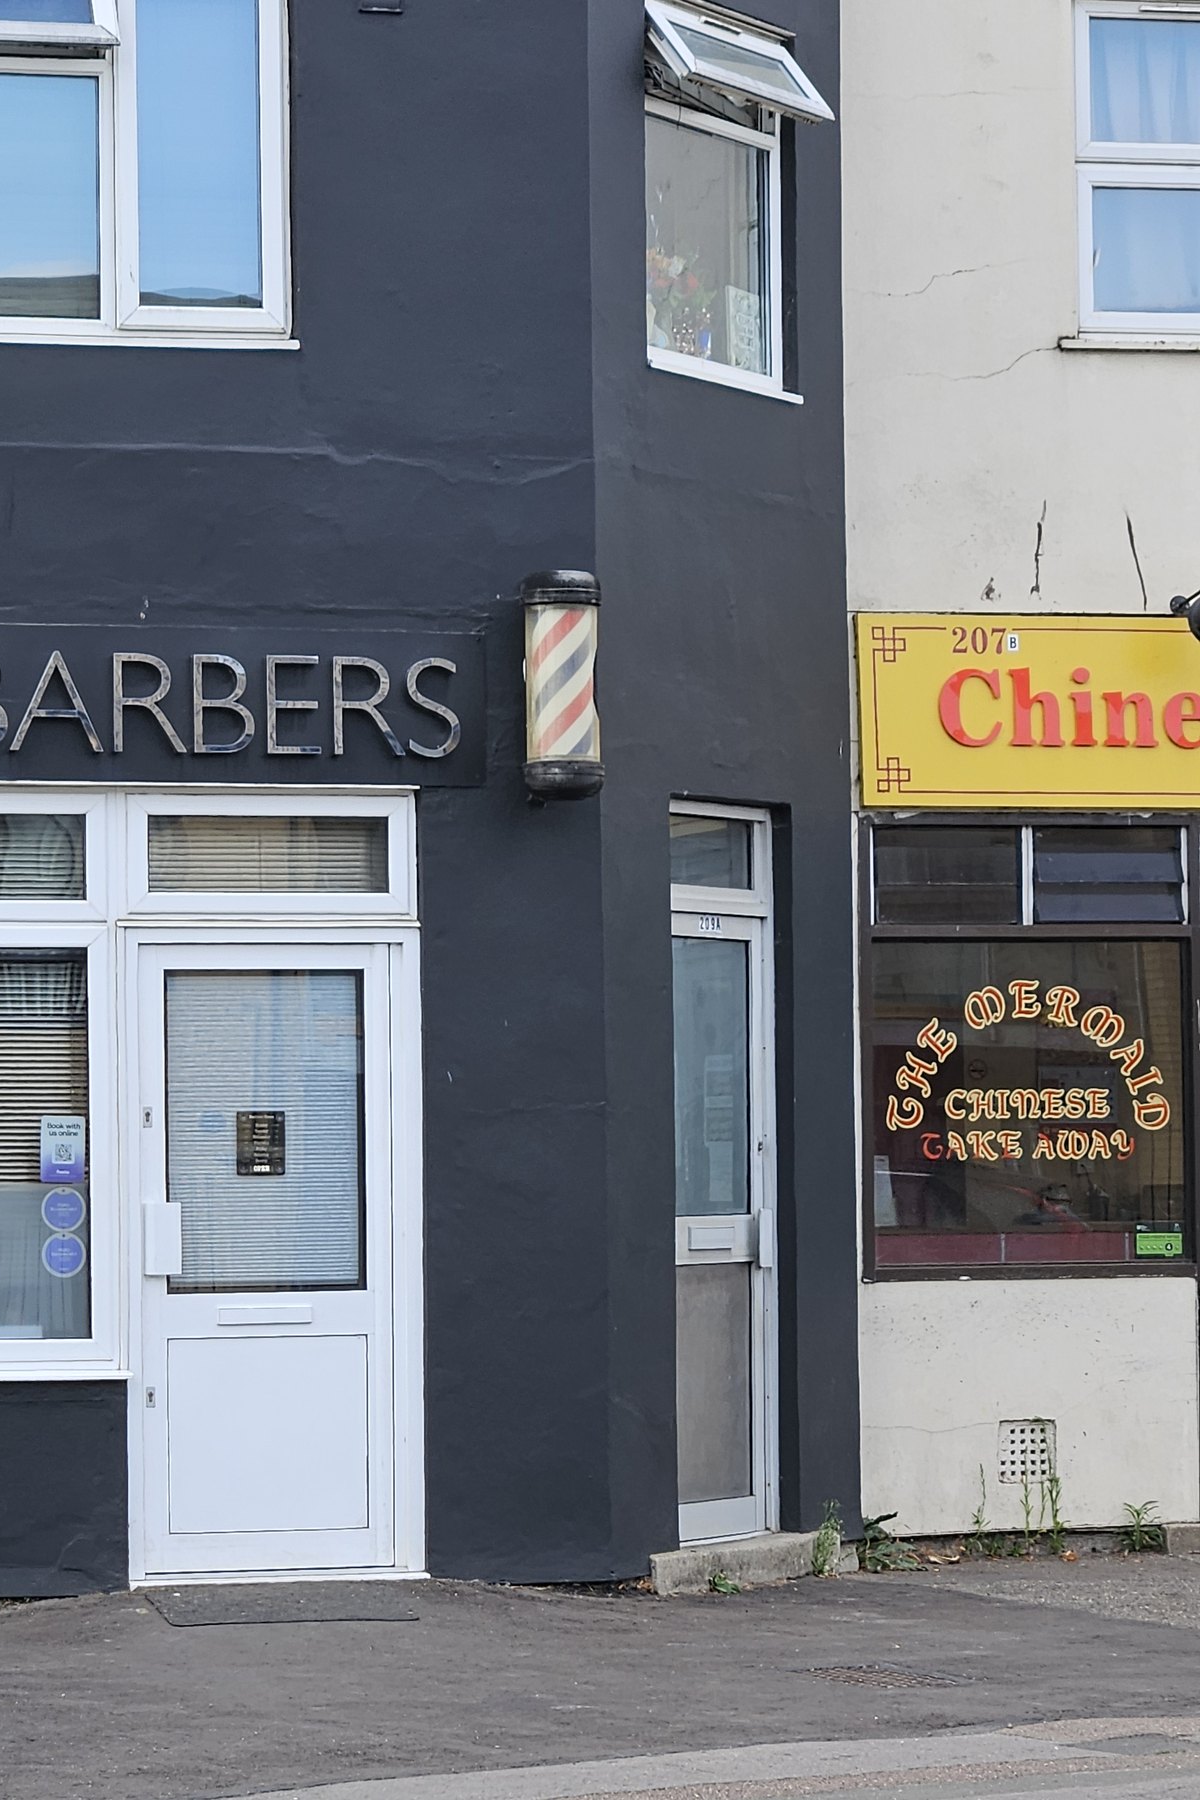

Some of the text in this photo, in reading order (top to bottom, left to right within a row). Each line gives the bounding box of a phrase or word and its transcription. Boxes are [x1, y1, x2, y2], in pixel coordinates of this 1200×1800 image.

[699, 916, 721, 931] 209A
[886, 979, 1171, 1131] THE MERMAID
[944, 1087, 1111, 1121] CHINESE
[920, 1129, 1136, 1161] TAKE AWAY
